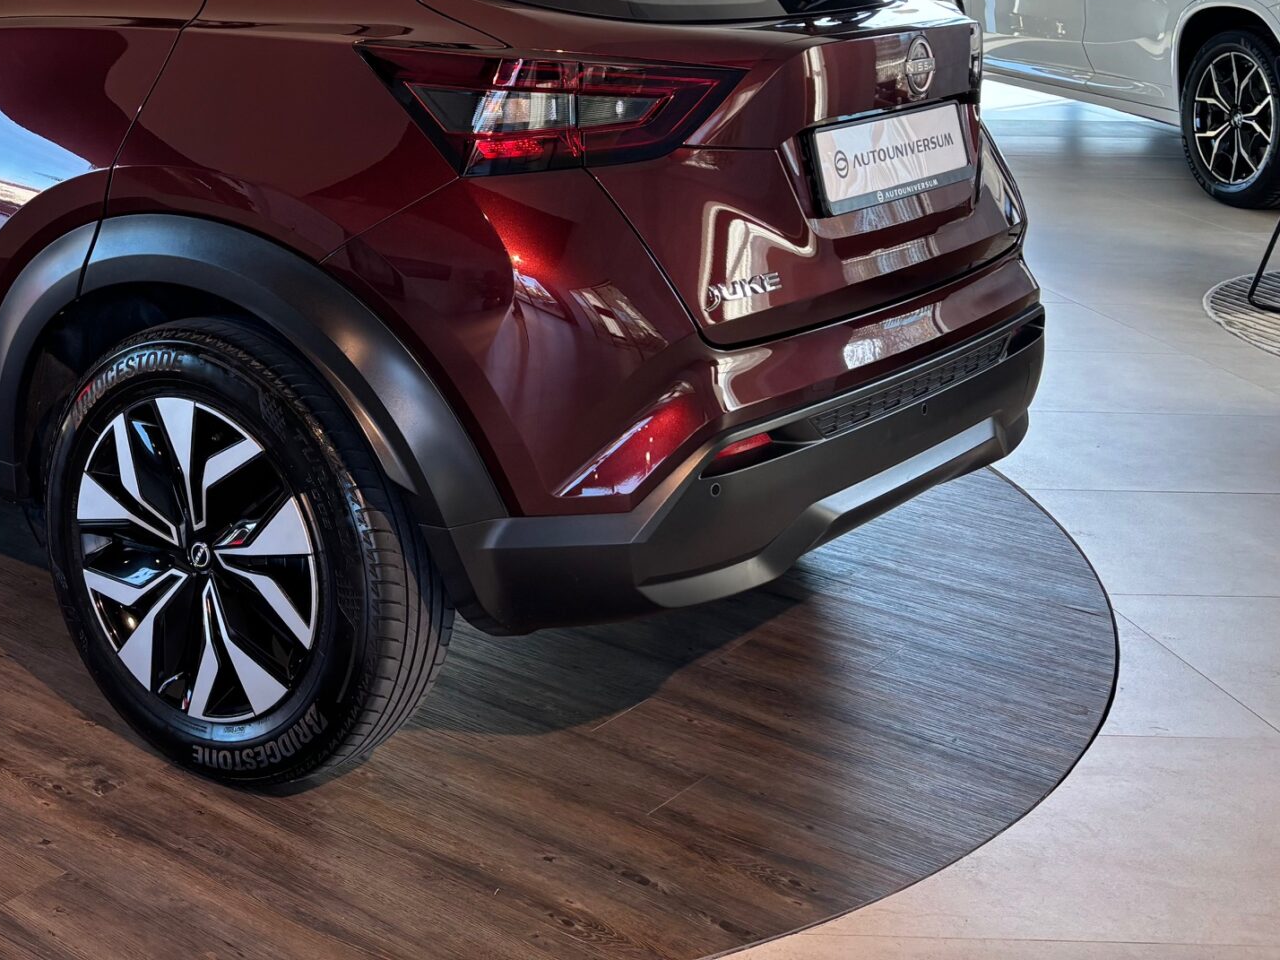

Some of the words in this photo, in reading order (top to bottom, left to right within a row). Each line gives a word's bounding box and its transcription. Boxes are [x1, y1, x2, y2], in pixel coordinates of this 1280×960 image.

[853, 132, 954, 168] AUTOUNIVERSUM
[884, 178, 939, 199] AUTOUNIVERSUM
[704, 272, 783, 313] JUKE
[191, 702, 328, 771] BRIDGESTONE
